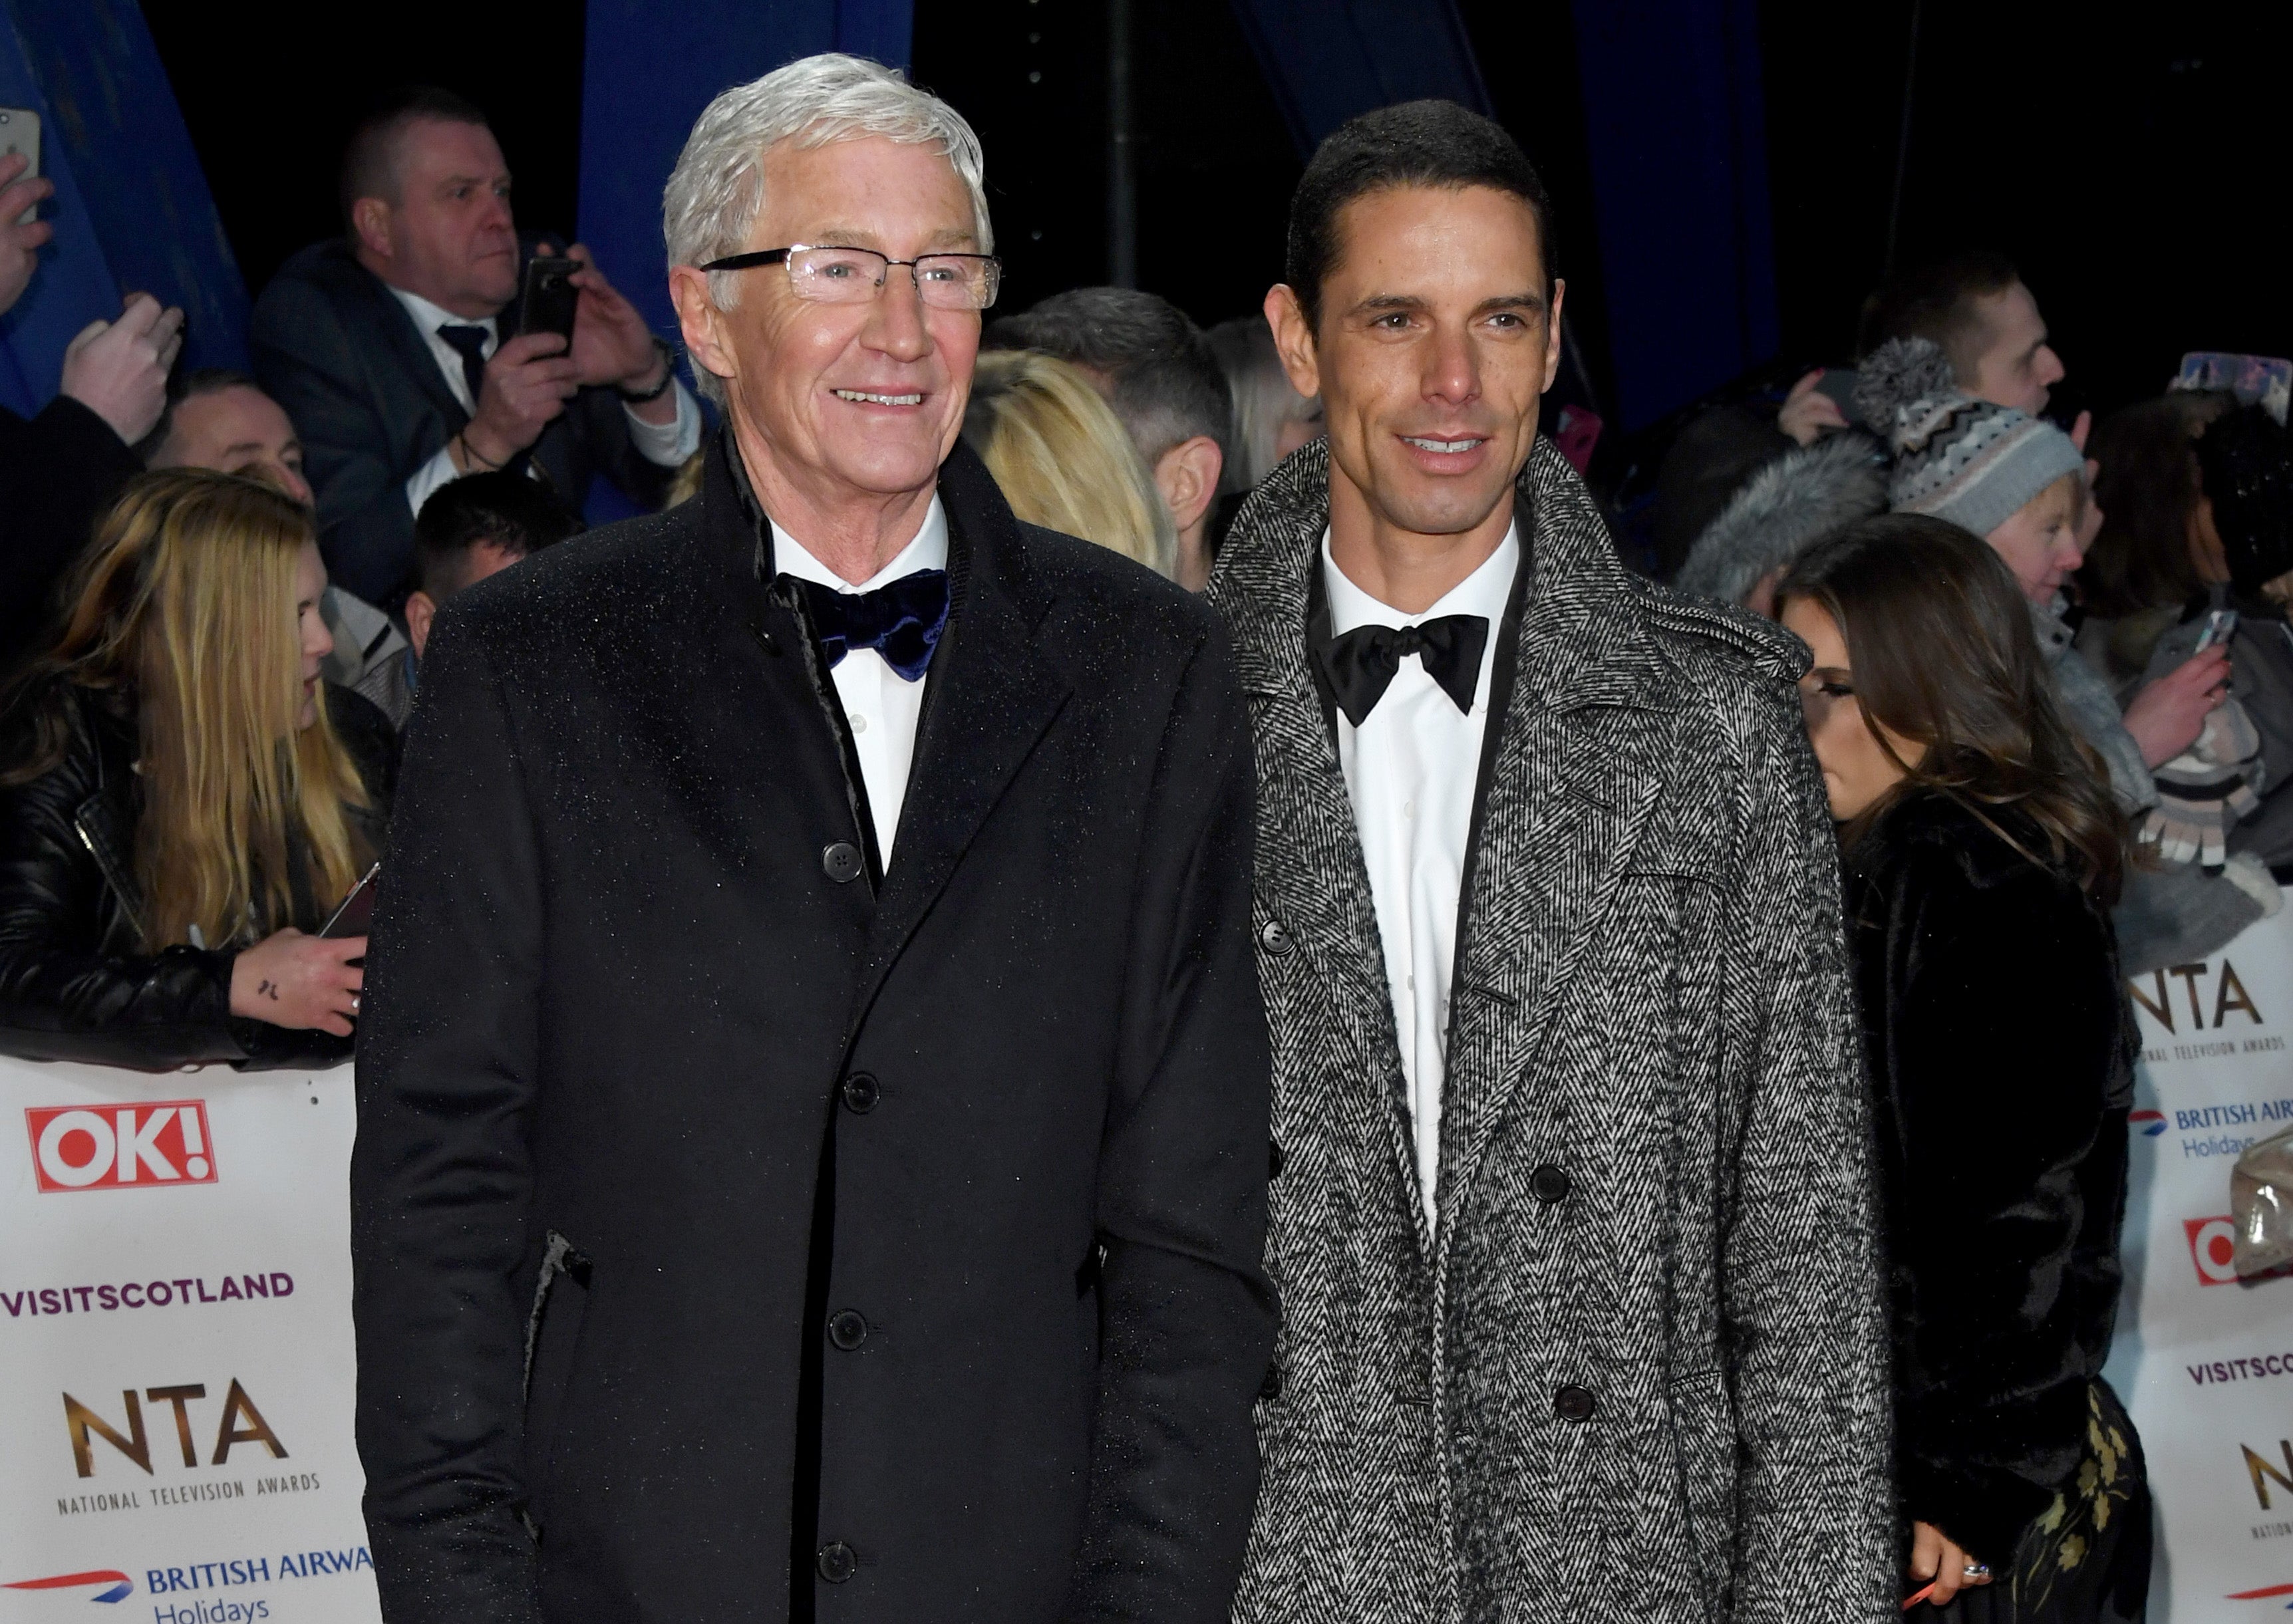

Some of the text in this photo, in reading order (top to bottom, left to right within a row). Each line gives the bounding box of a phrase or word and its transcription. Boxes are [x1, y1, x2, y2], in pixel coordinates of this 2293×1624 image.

[2175, 1103, 2256, 1130] BRITISH
[39, 1107, 209, 1186] OK!
[0, 1272, 294, 1317] VISITSCOTLAND
[63, 1377, 289, 1478] NTA
[57, 1473, 321, 1516] NATIONAL TELEVISION AWARDS
[146, 1557, 271, 1594] BRITISH
[154, 1598, 269, 1624] Holidays
